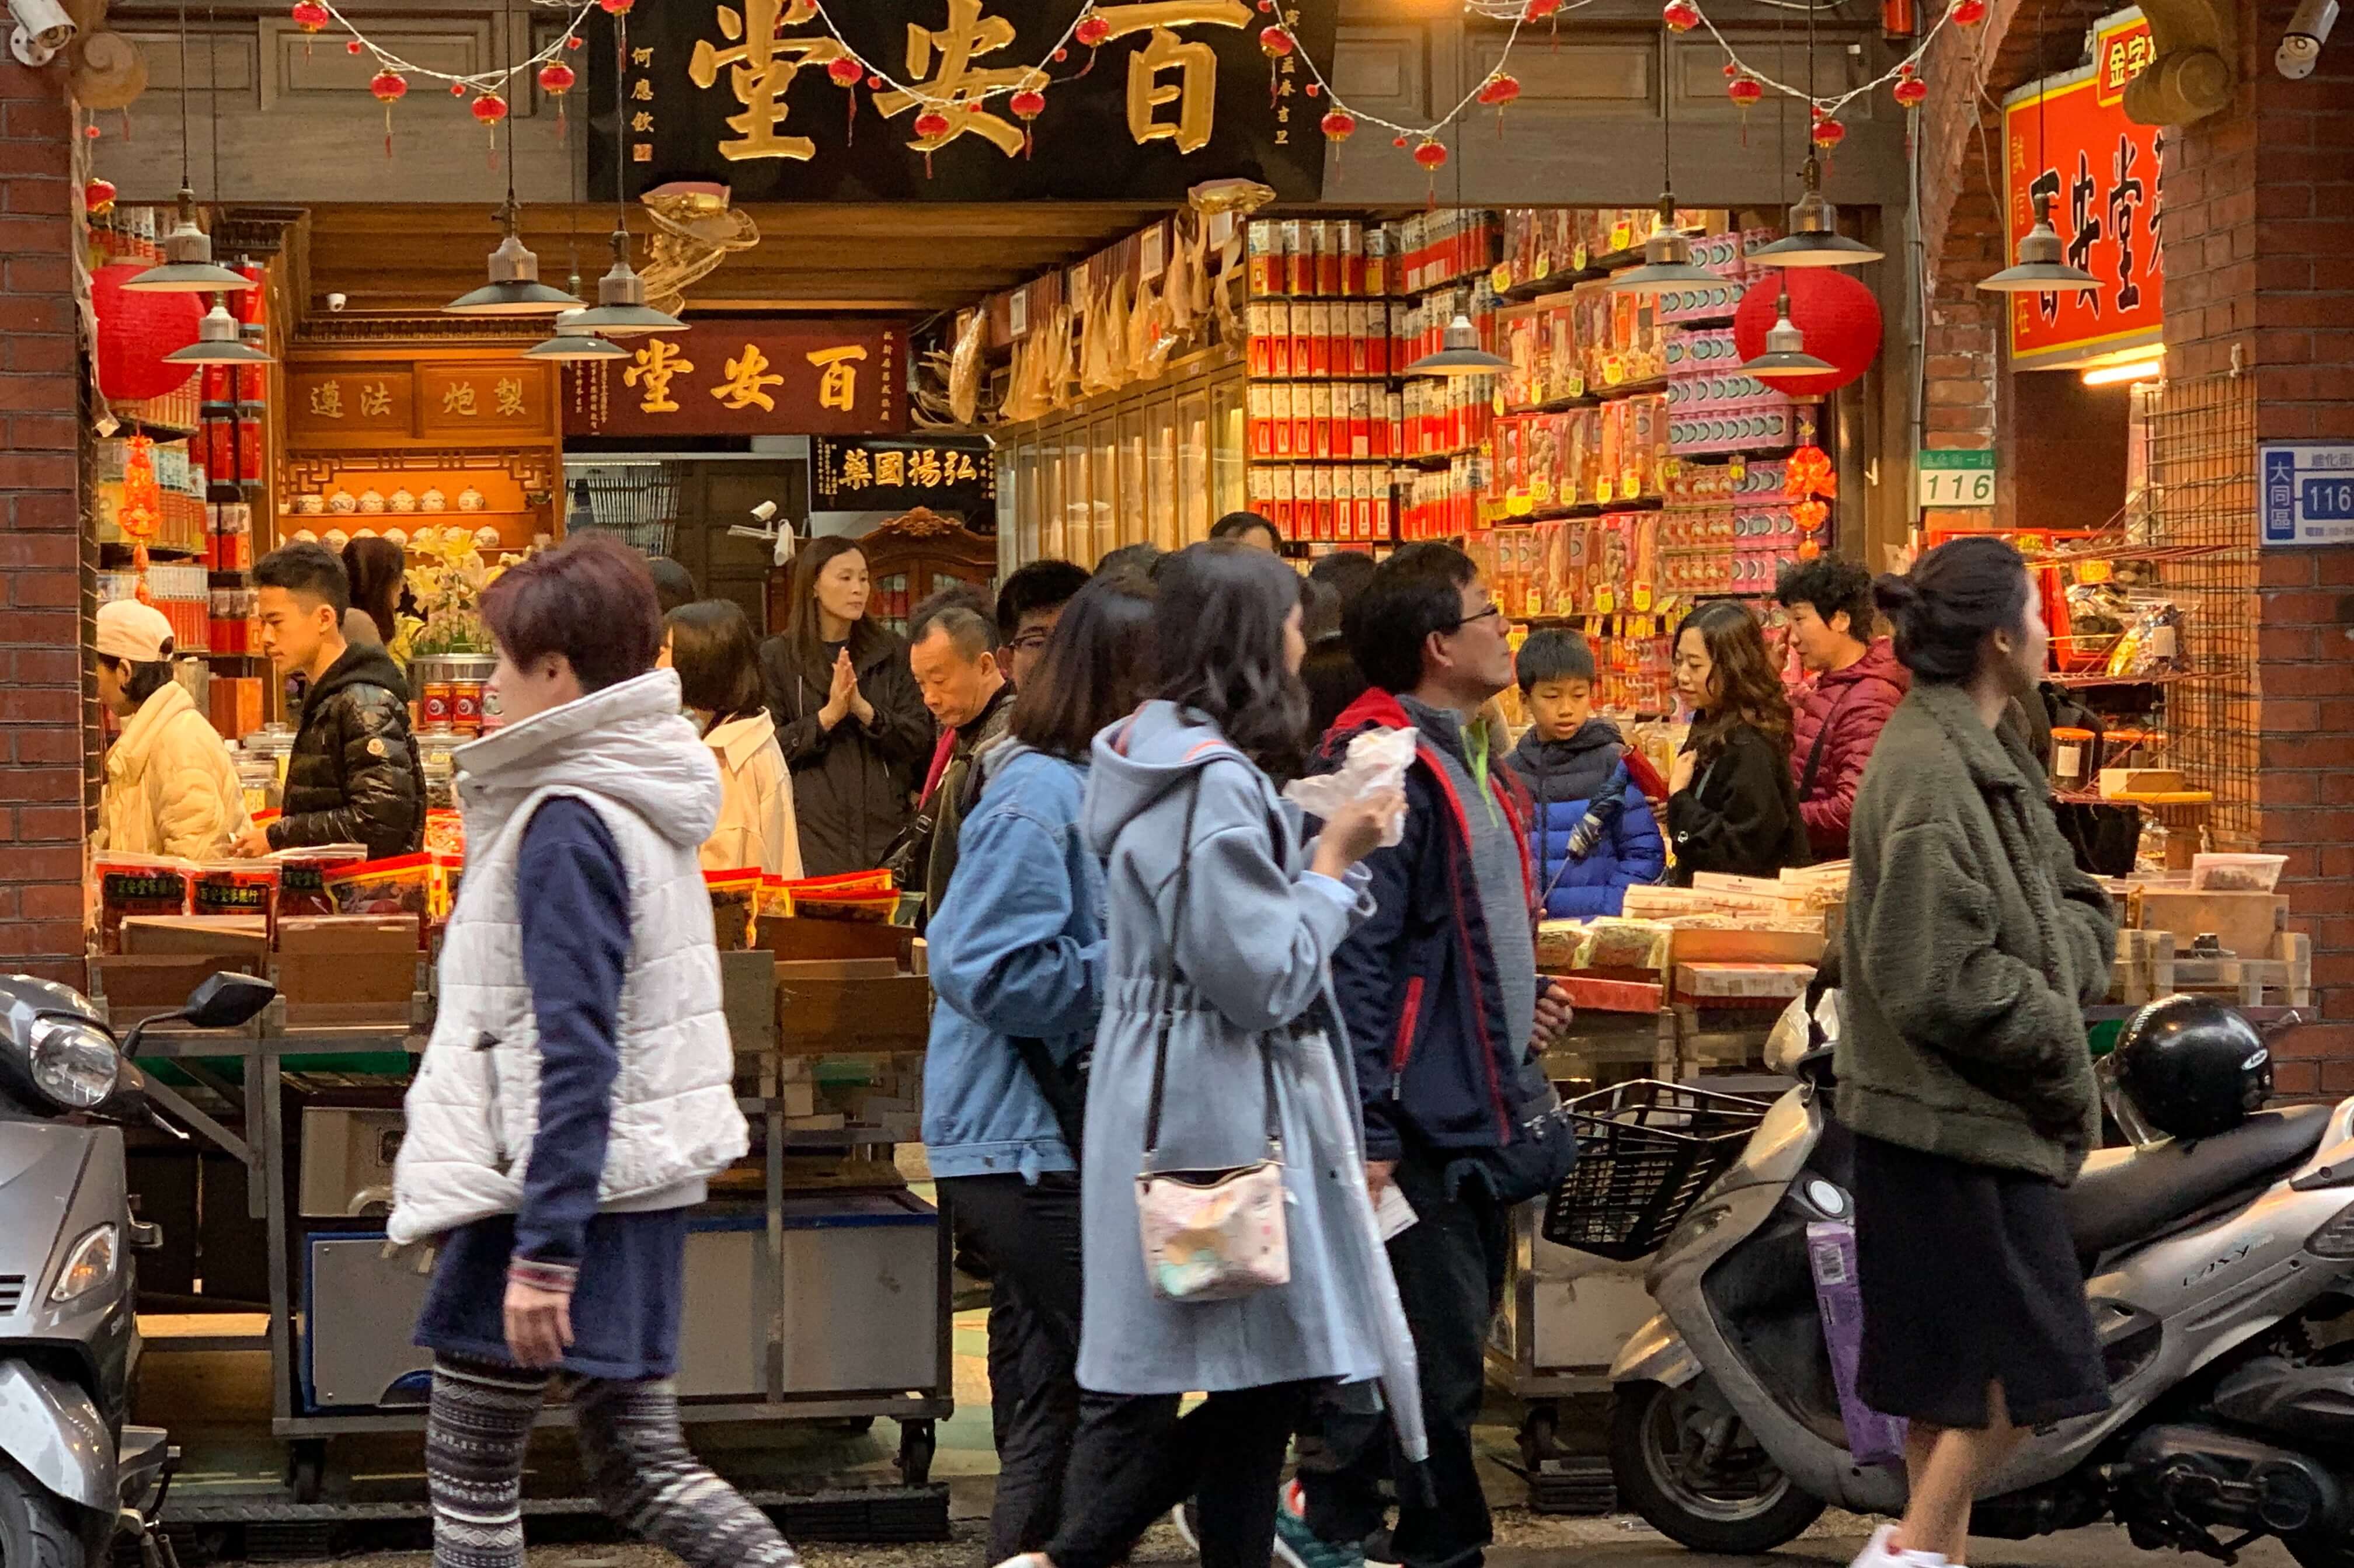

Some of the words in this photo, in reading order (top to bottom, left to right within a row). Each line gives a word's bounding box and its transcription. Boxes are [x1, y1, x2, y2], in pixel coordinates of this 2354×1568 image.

[689, 0, 1253, 161] 百安堂
[624, 339, 868, 413] 百安堂
[839, 448, 977, 490] 弘揚國藥
[1927, 475, 1991, 500] 116
[2269, 461, 2292, 530] 大同區
[2310, 486, 2352, 512] 116
